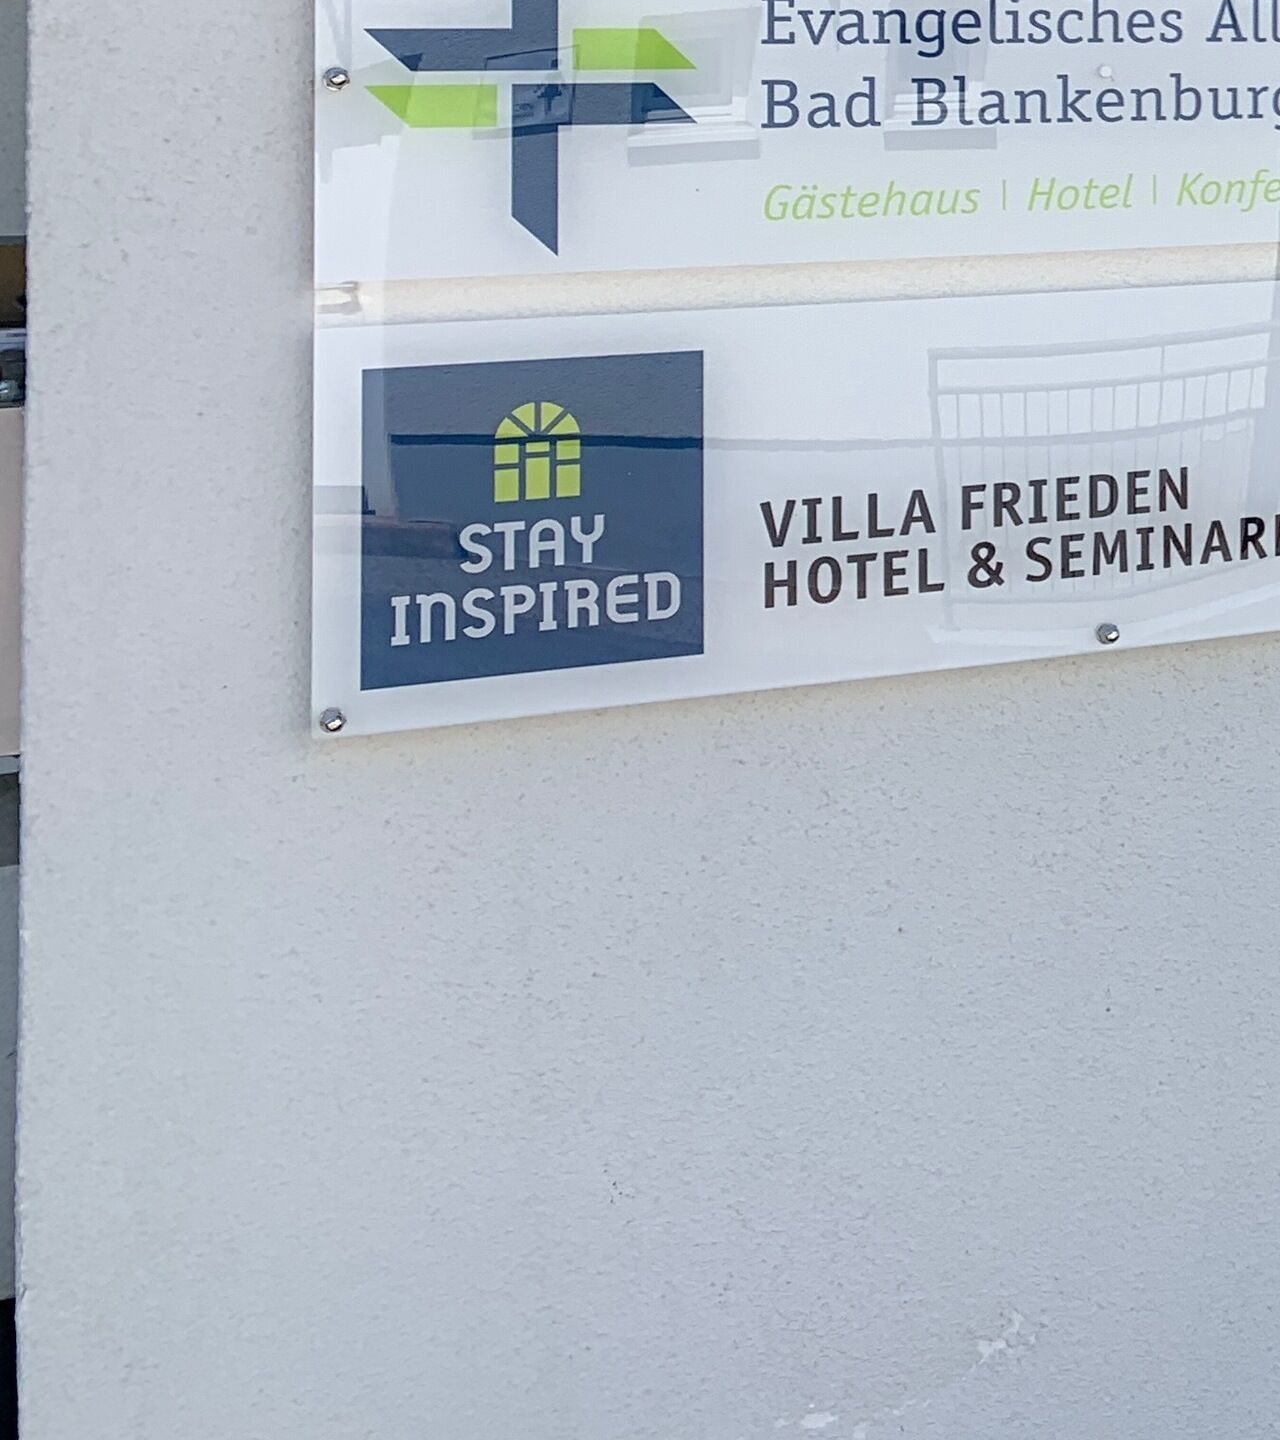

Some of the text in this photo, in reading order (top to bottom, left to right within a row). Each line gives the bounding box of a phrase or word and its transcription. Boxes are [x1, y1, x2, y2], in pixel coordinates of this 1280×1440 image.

[761, 79, 879, 128] Bad
[765, 181, 980, 220] Gästehaus
[1028, 174, 1132, 210] Hotel
[760, 467, 1191, 547] VILLA FRIEDEN
[459, 514, 605, 573] STAY
[765, 553, 944, 608] HOTEL
[968, 542, 1004, 588] &
